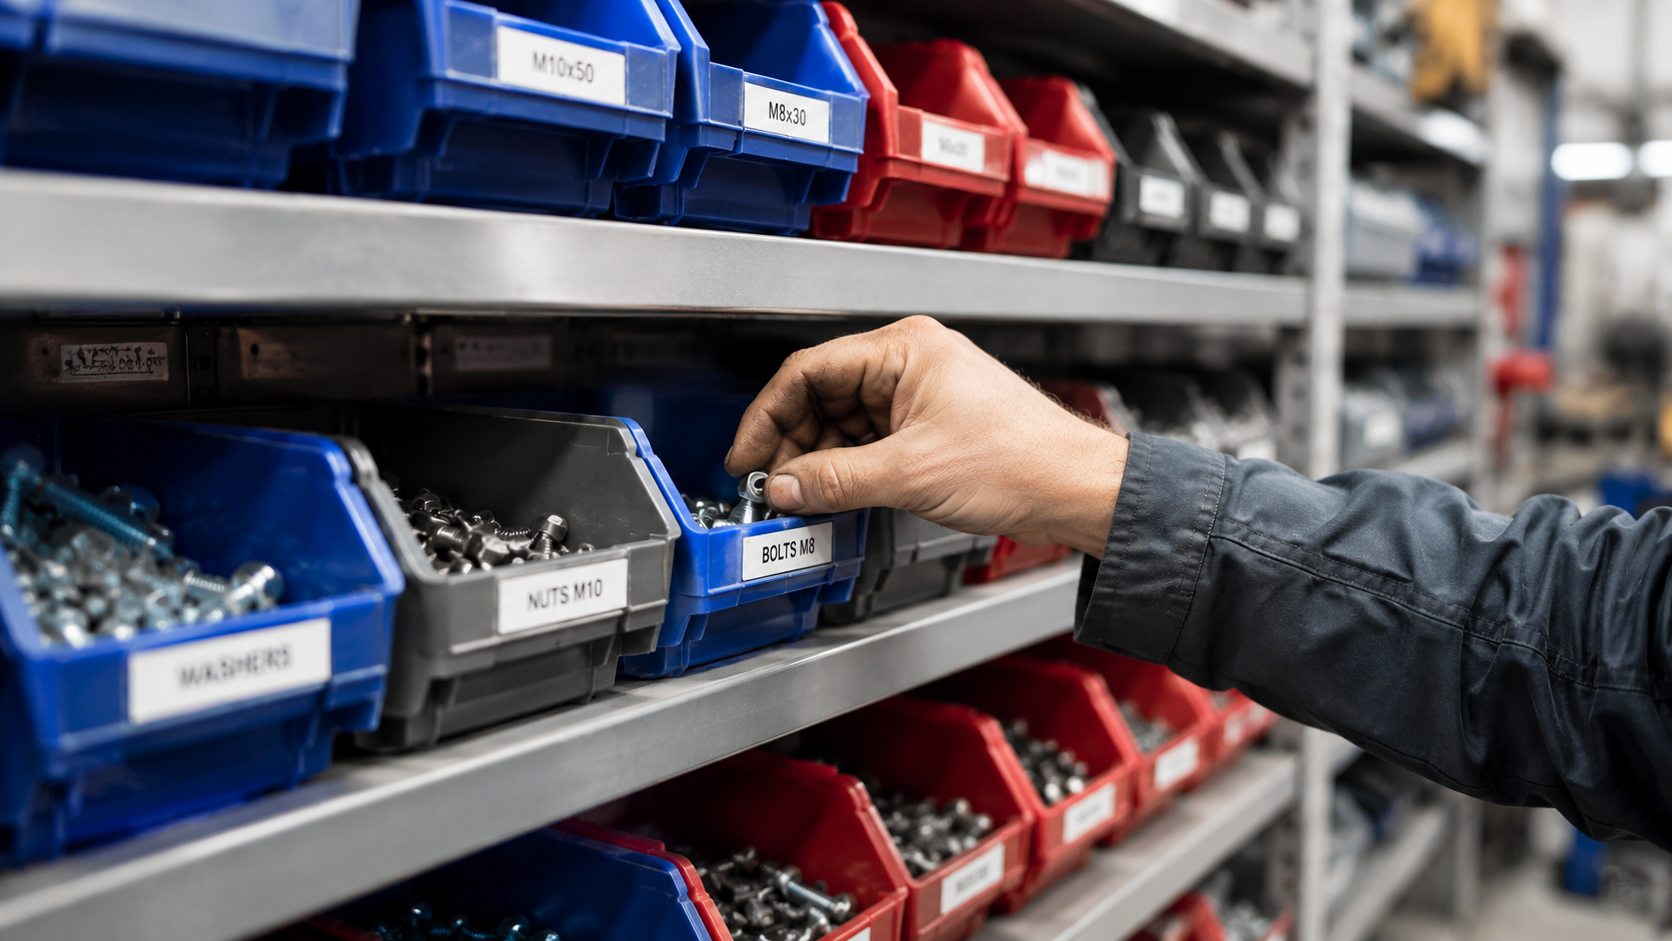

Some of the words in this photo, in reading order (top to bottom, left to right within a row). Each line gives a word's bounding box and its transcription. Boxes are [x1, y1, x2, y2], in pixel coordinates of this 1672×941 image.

[532, 51, 594, 83] M10x50
[768, 101, 806, 126] M8x30
[762, 544, 797, 564] BOLTS
[799, 537, 815, 556] M8
[528, 585, 569, 611] NUTS
[573, 578, 603, 600] M10
[179, 645, 291, 688] WASHERS
